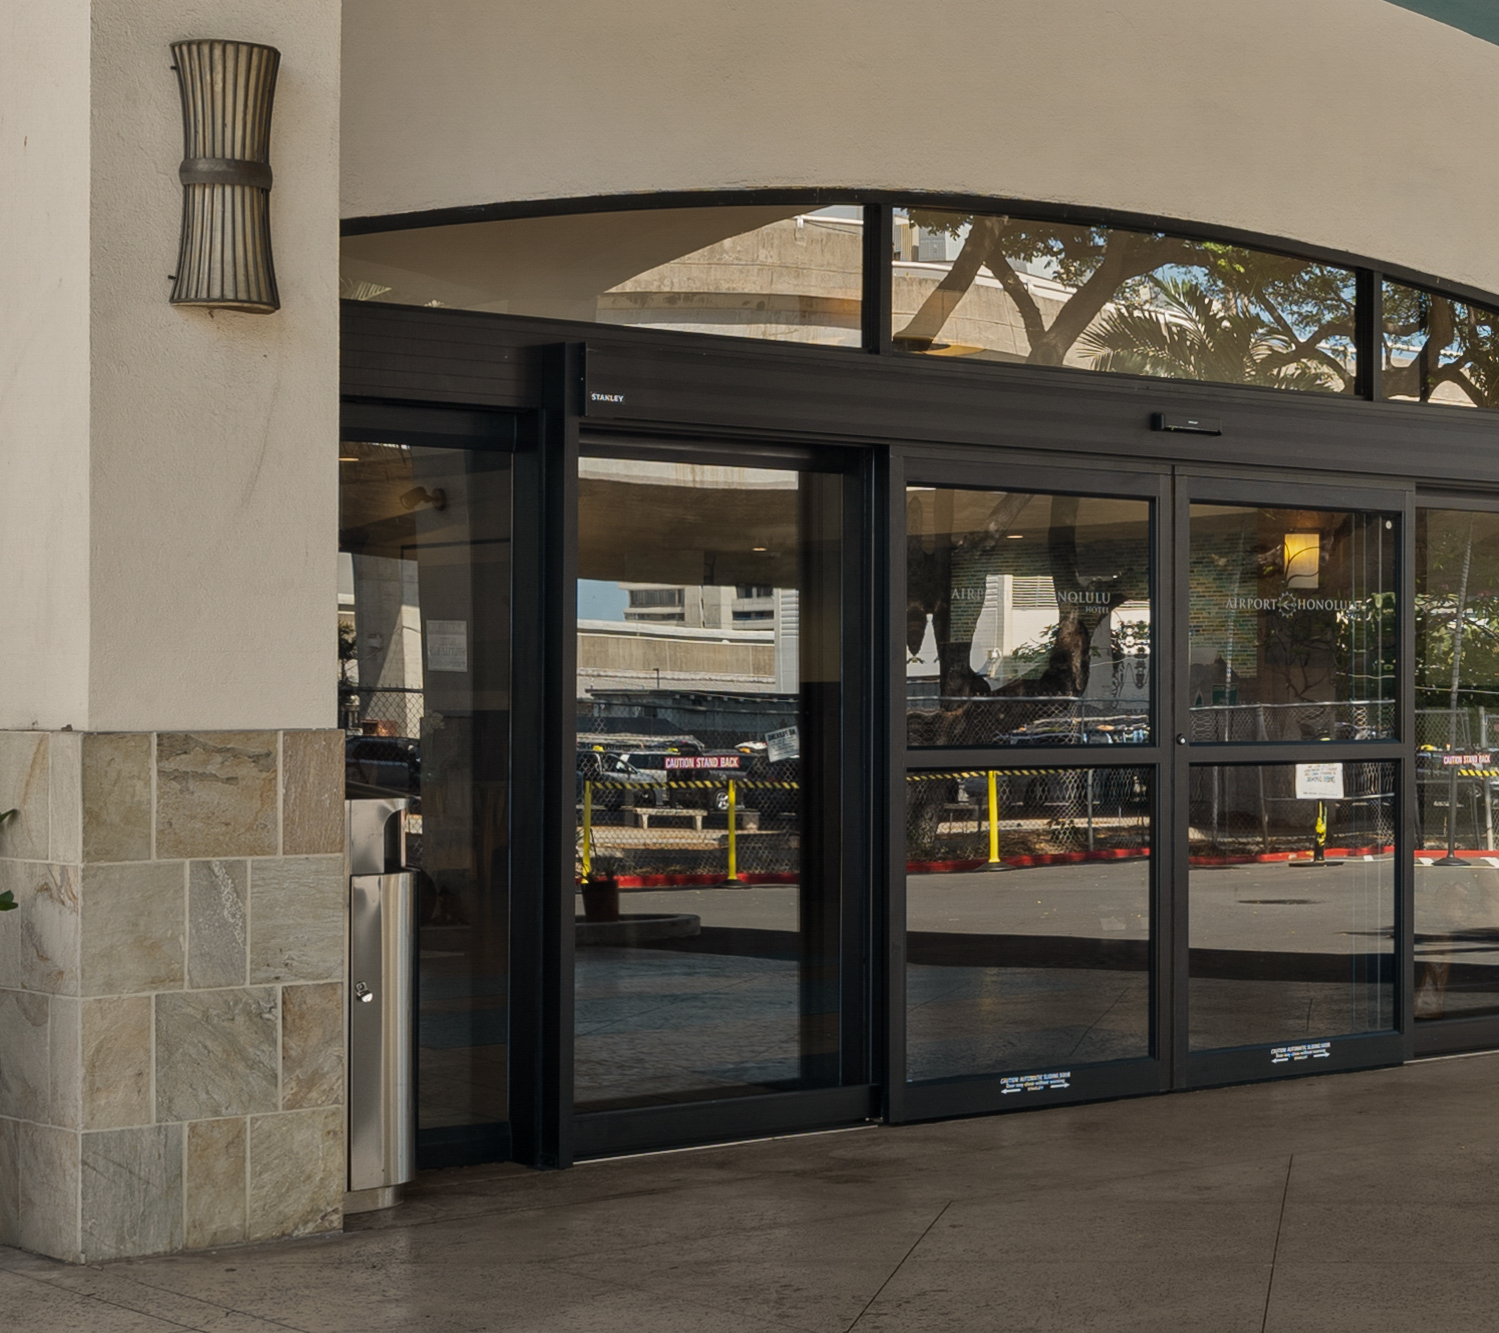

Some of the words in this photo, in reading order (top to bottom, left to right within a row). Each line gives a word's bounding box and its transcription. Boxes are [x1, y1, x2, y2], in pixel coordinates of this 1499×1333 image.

[591, 393, 624, 402] STANLEY
[1225, 598, 1278, 610] AIRPORT
[665, 757, 694, 768] CAUTION
[696, 757, 718, 767] STAND
[720, 756, 739, 767] BACK
[1443, 755, 1462, 765] CAUTION
